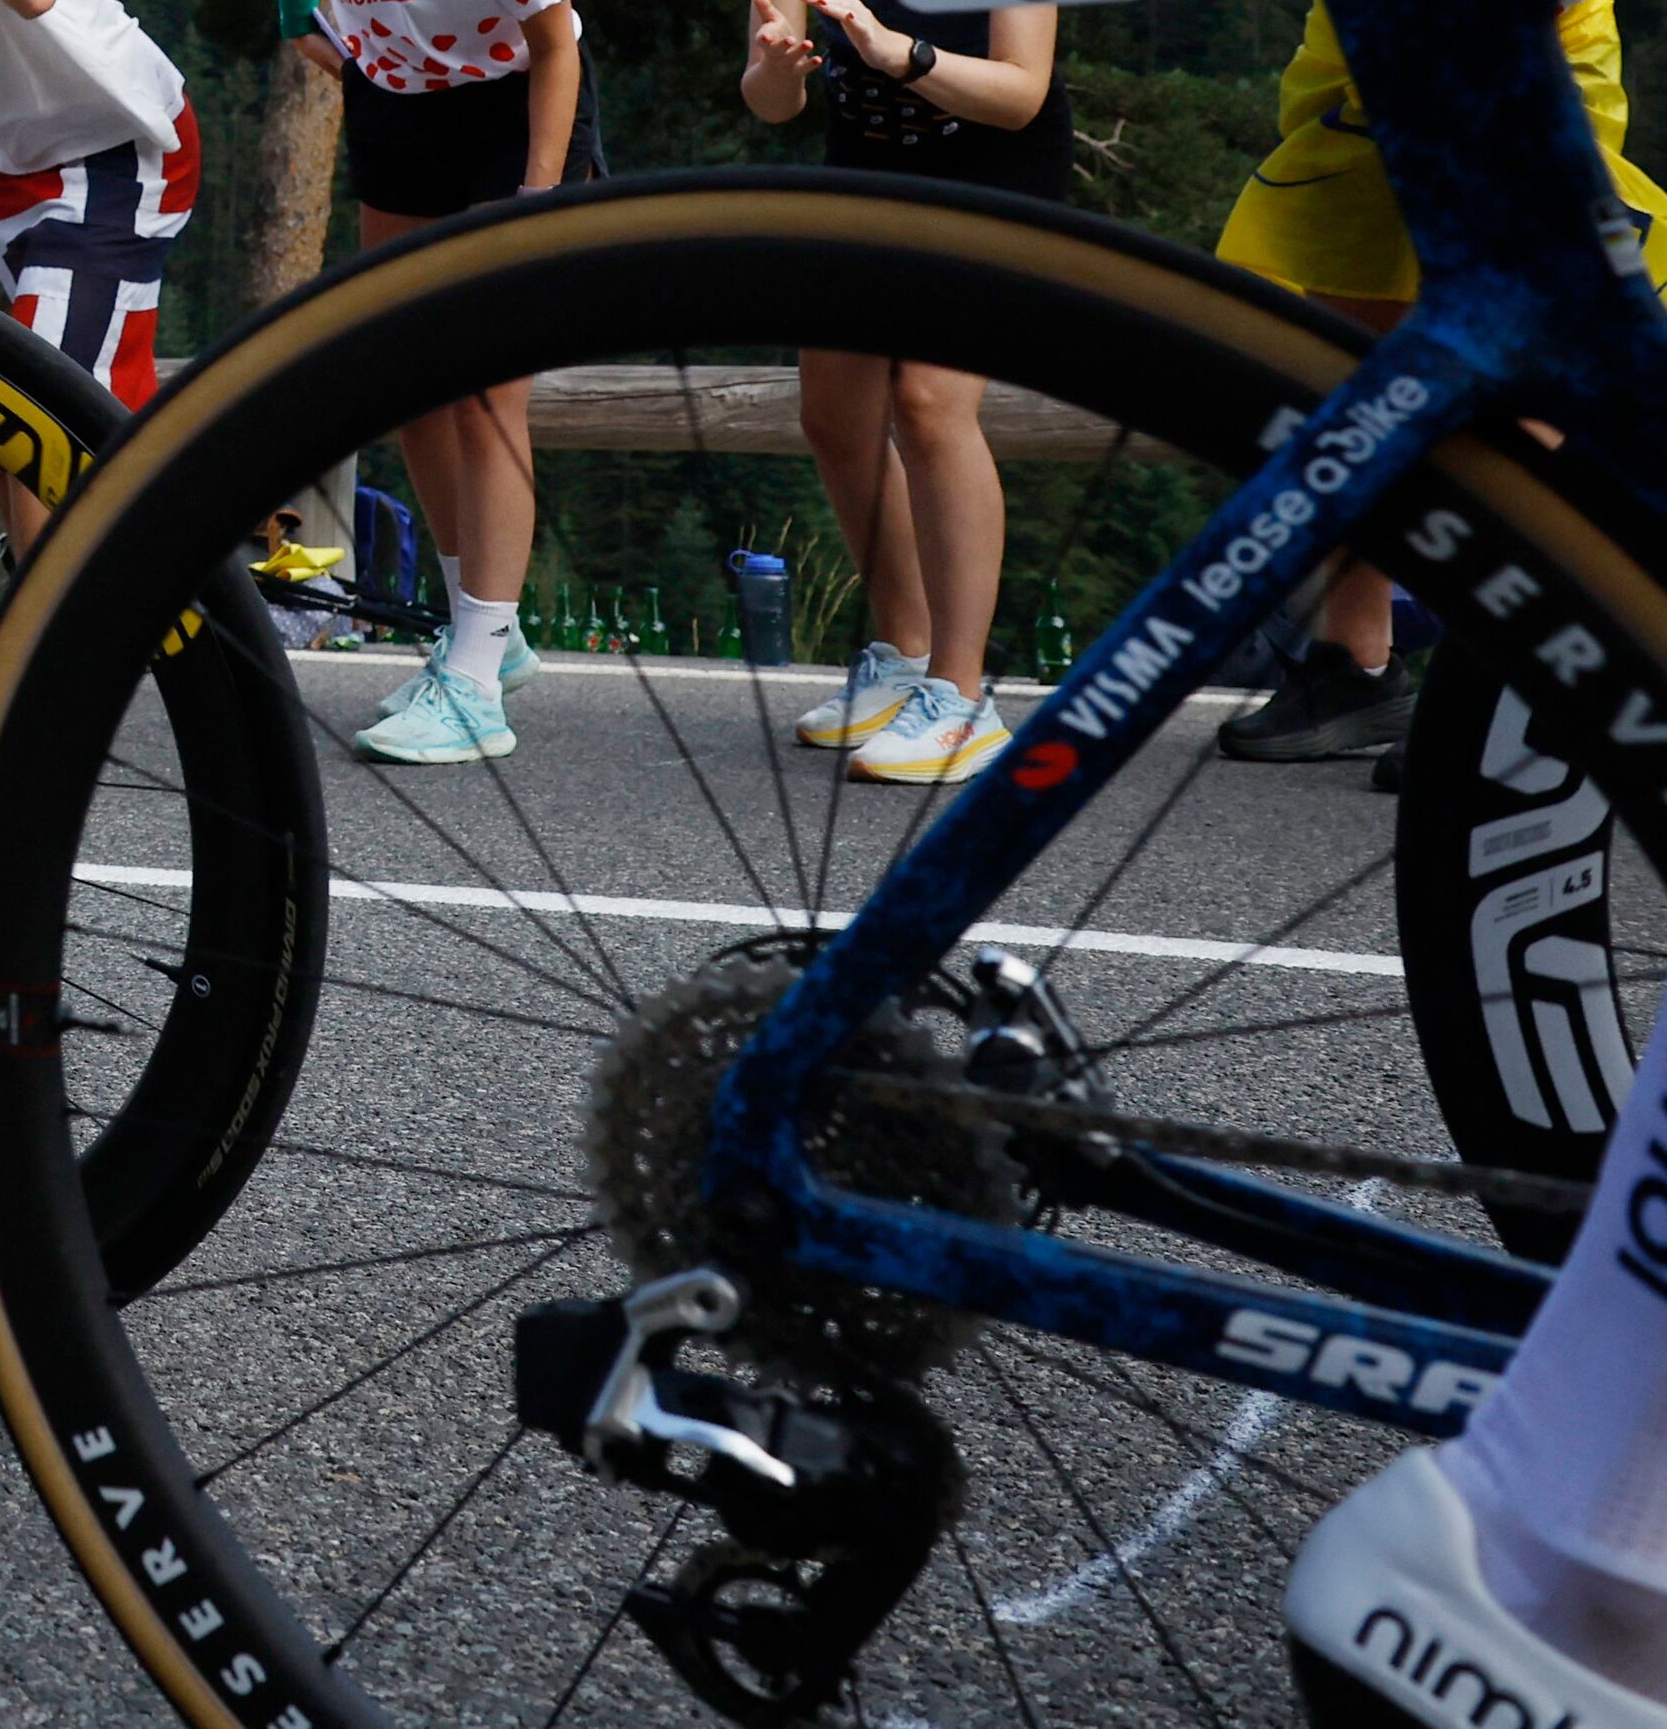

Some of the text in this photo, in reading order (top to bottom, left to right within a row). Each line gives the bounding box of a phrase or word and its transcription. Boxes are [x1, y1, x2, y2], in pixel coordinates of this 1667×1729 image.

[1058, 613, 1195, 742] VISMA
[1182, 487, 1315, 614] lease
[1315, 372, 1430, 460] bike
[1561, 868, 1594, 897] 4.5
[1354, 1605, 1575, 1729] nim
